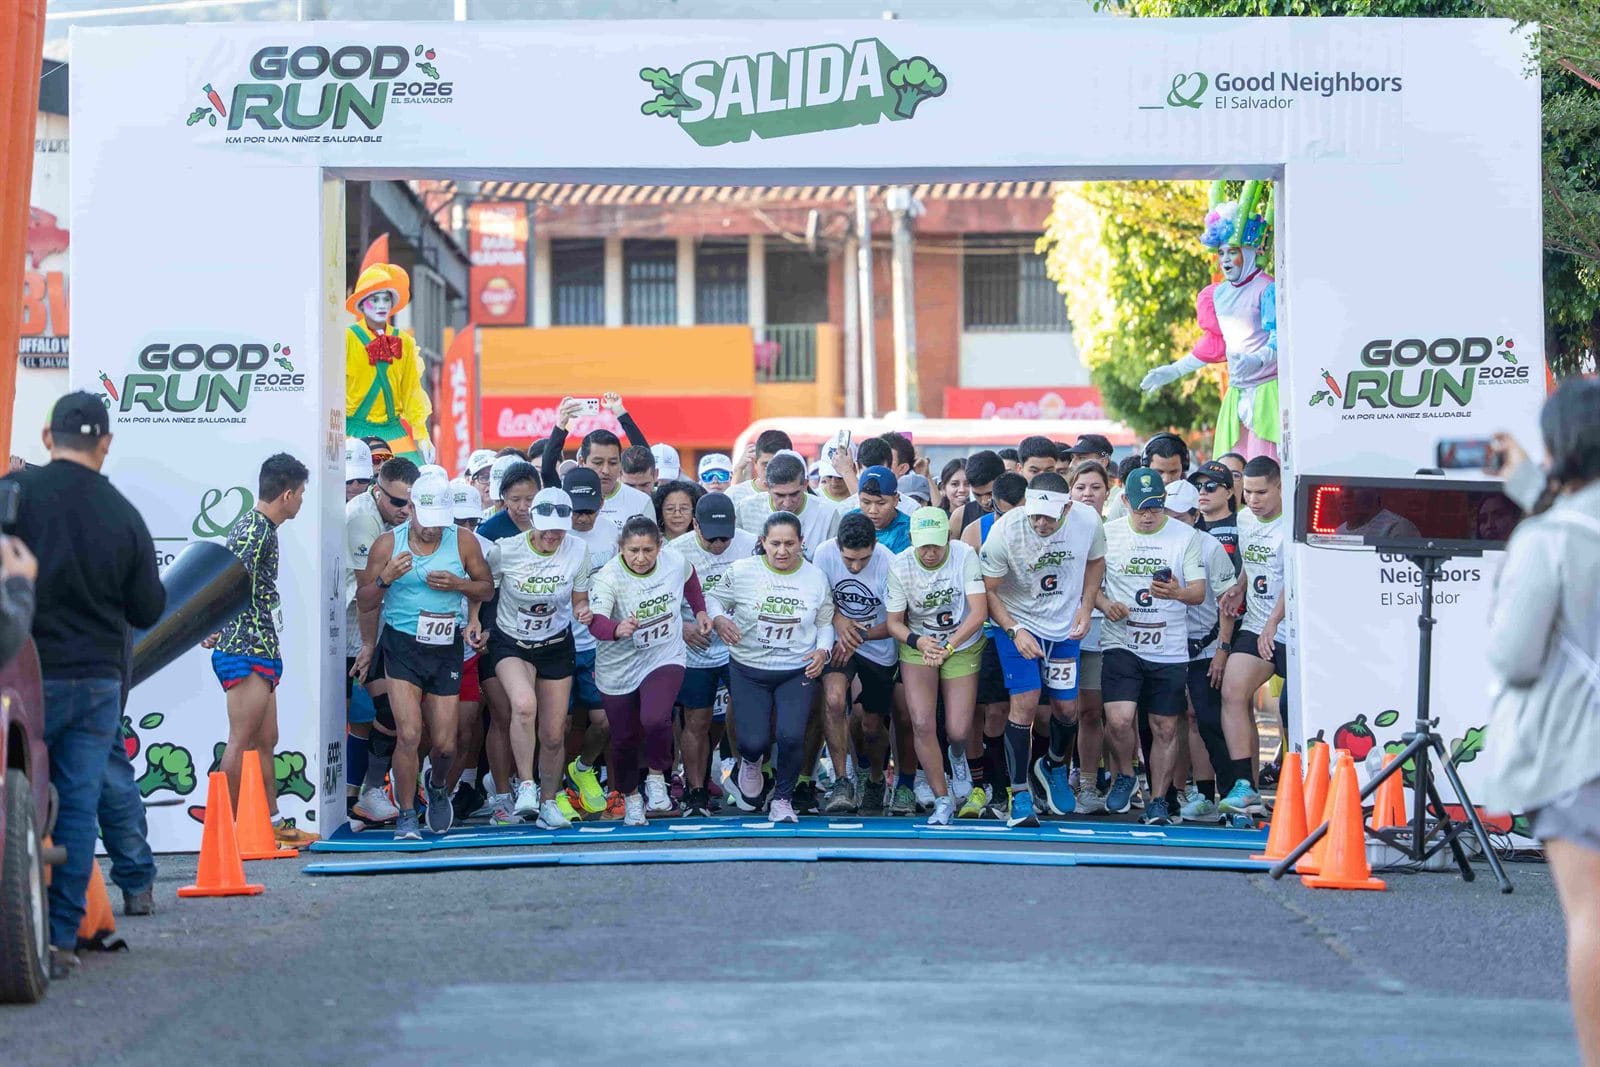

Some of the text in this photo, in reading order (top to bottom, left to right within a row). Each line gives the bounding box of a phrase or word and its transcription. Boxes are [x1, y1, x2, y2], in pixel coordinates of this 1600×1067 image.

[249, 45, 410, 81] GOOD
[677, 38, 894, 132] SALIDA
[1214, 71, 1402, 97] Good Neighbors
[227, 82, 453, 130] RUN 2026
[1215, 96, 1293, 109] El Salvador
[225, 136, 242, 144] KM
[292, 134, 321, 143] NIÑEZ
[322, 135, 382, 143] SALUDABLE
[138, 343, 270, 372] GOOD
[1360, 337, 1493, 368] GOOD
[119, 373, 305, 413] RUN 2026
[1343, 366, 1529, 410] RUN 2026
[1376, 412, 1395, 420] UNA
[1422, 411, 1472, 419] SALUDABLE
[1248, 544, 1271, 554] GOOD
[1130, 557, 1162, 565] GOOD
[1244, 551, 1267, 562] RUN
[1125, 564, 1157, 575] RUN
[527, 575, 560, 583] GOOD
[520, 583, 556, 593] RUN
[639, 593, 669, 609] GOOD
[766, 596, 799, 606] GOOD
[1381, 592, 1393, 605] El
[635, 602, 667, 619] RUN
[760, 603, 794, 615] RUN
[425, 622, 453, 636] 106
[523, 618, 552, 631] 131
[641, 623, 669, 643] 112
[764, 626, 794, 640] 111
[1132, 631, 1161, 645] 120
[1044, 666, 1072, 680] 125
